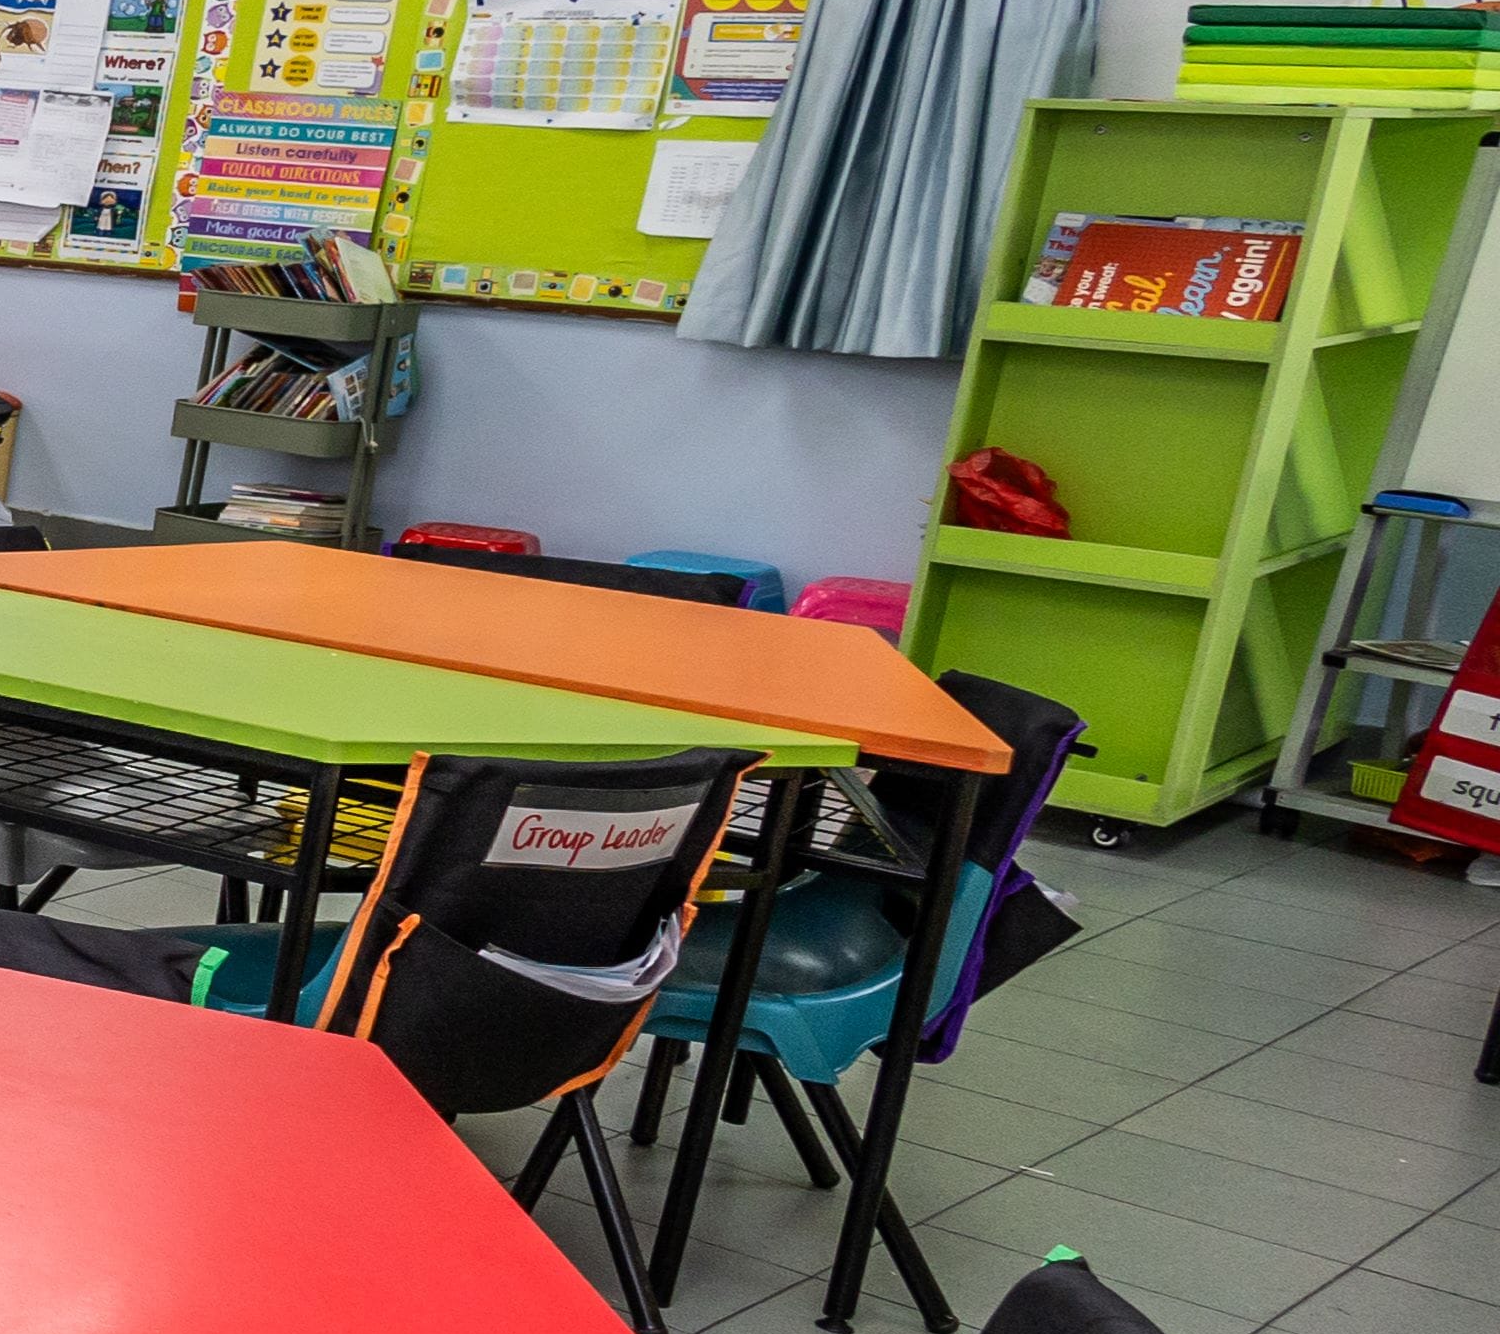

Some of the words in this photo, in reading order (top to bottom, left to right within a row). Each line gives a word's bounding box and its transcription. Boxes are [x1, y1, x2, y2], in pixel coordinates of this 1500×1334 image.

[104, 55, 166, 71] Where?
[218, 97, 334, 119] CLASSROOM
[340, 105, 395, 121] RULES
[218, 124, 273, 137] ALWAYS
[278, 126, 300, 138] DO
[306, 128, 344, 141] YOUR
[351, 130, 385, 143] BEST
[236, 142, 279, 157] Listen
[286, 146, 358, 164] carefully
[221, 163, 274, 177] FOLLOW
[280, 167, 361, 185] DIRECTIONS
[207, 182, 242, 193] Raise
[245, 186, 276, 197] your
[279, 187, 312, 199] hand
[316, 191, 328, 201] to
[332, 193, 369, 206] speak
[209, 201, 240, 215] TREAT
[242, 203, 281, 219] OTHERS
[283, 205, 310, 220] WITH
[312, 208, 359, 225] RESPECT
[206, 220, 243, 235] Make
[246, 225, 282, 243] good
[191, 241, 272, 258] ENCOURAGE
[276, 247, 306, 262] EAC
[1226, 239, 1274, 307] again!
[511, 813, 596, 867] Group
[601, 818, 677, 851] Leader
